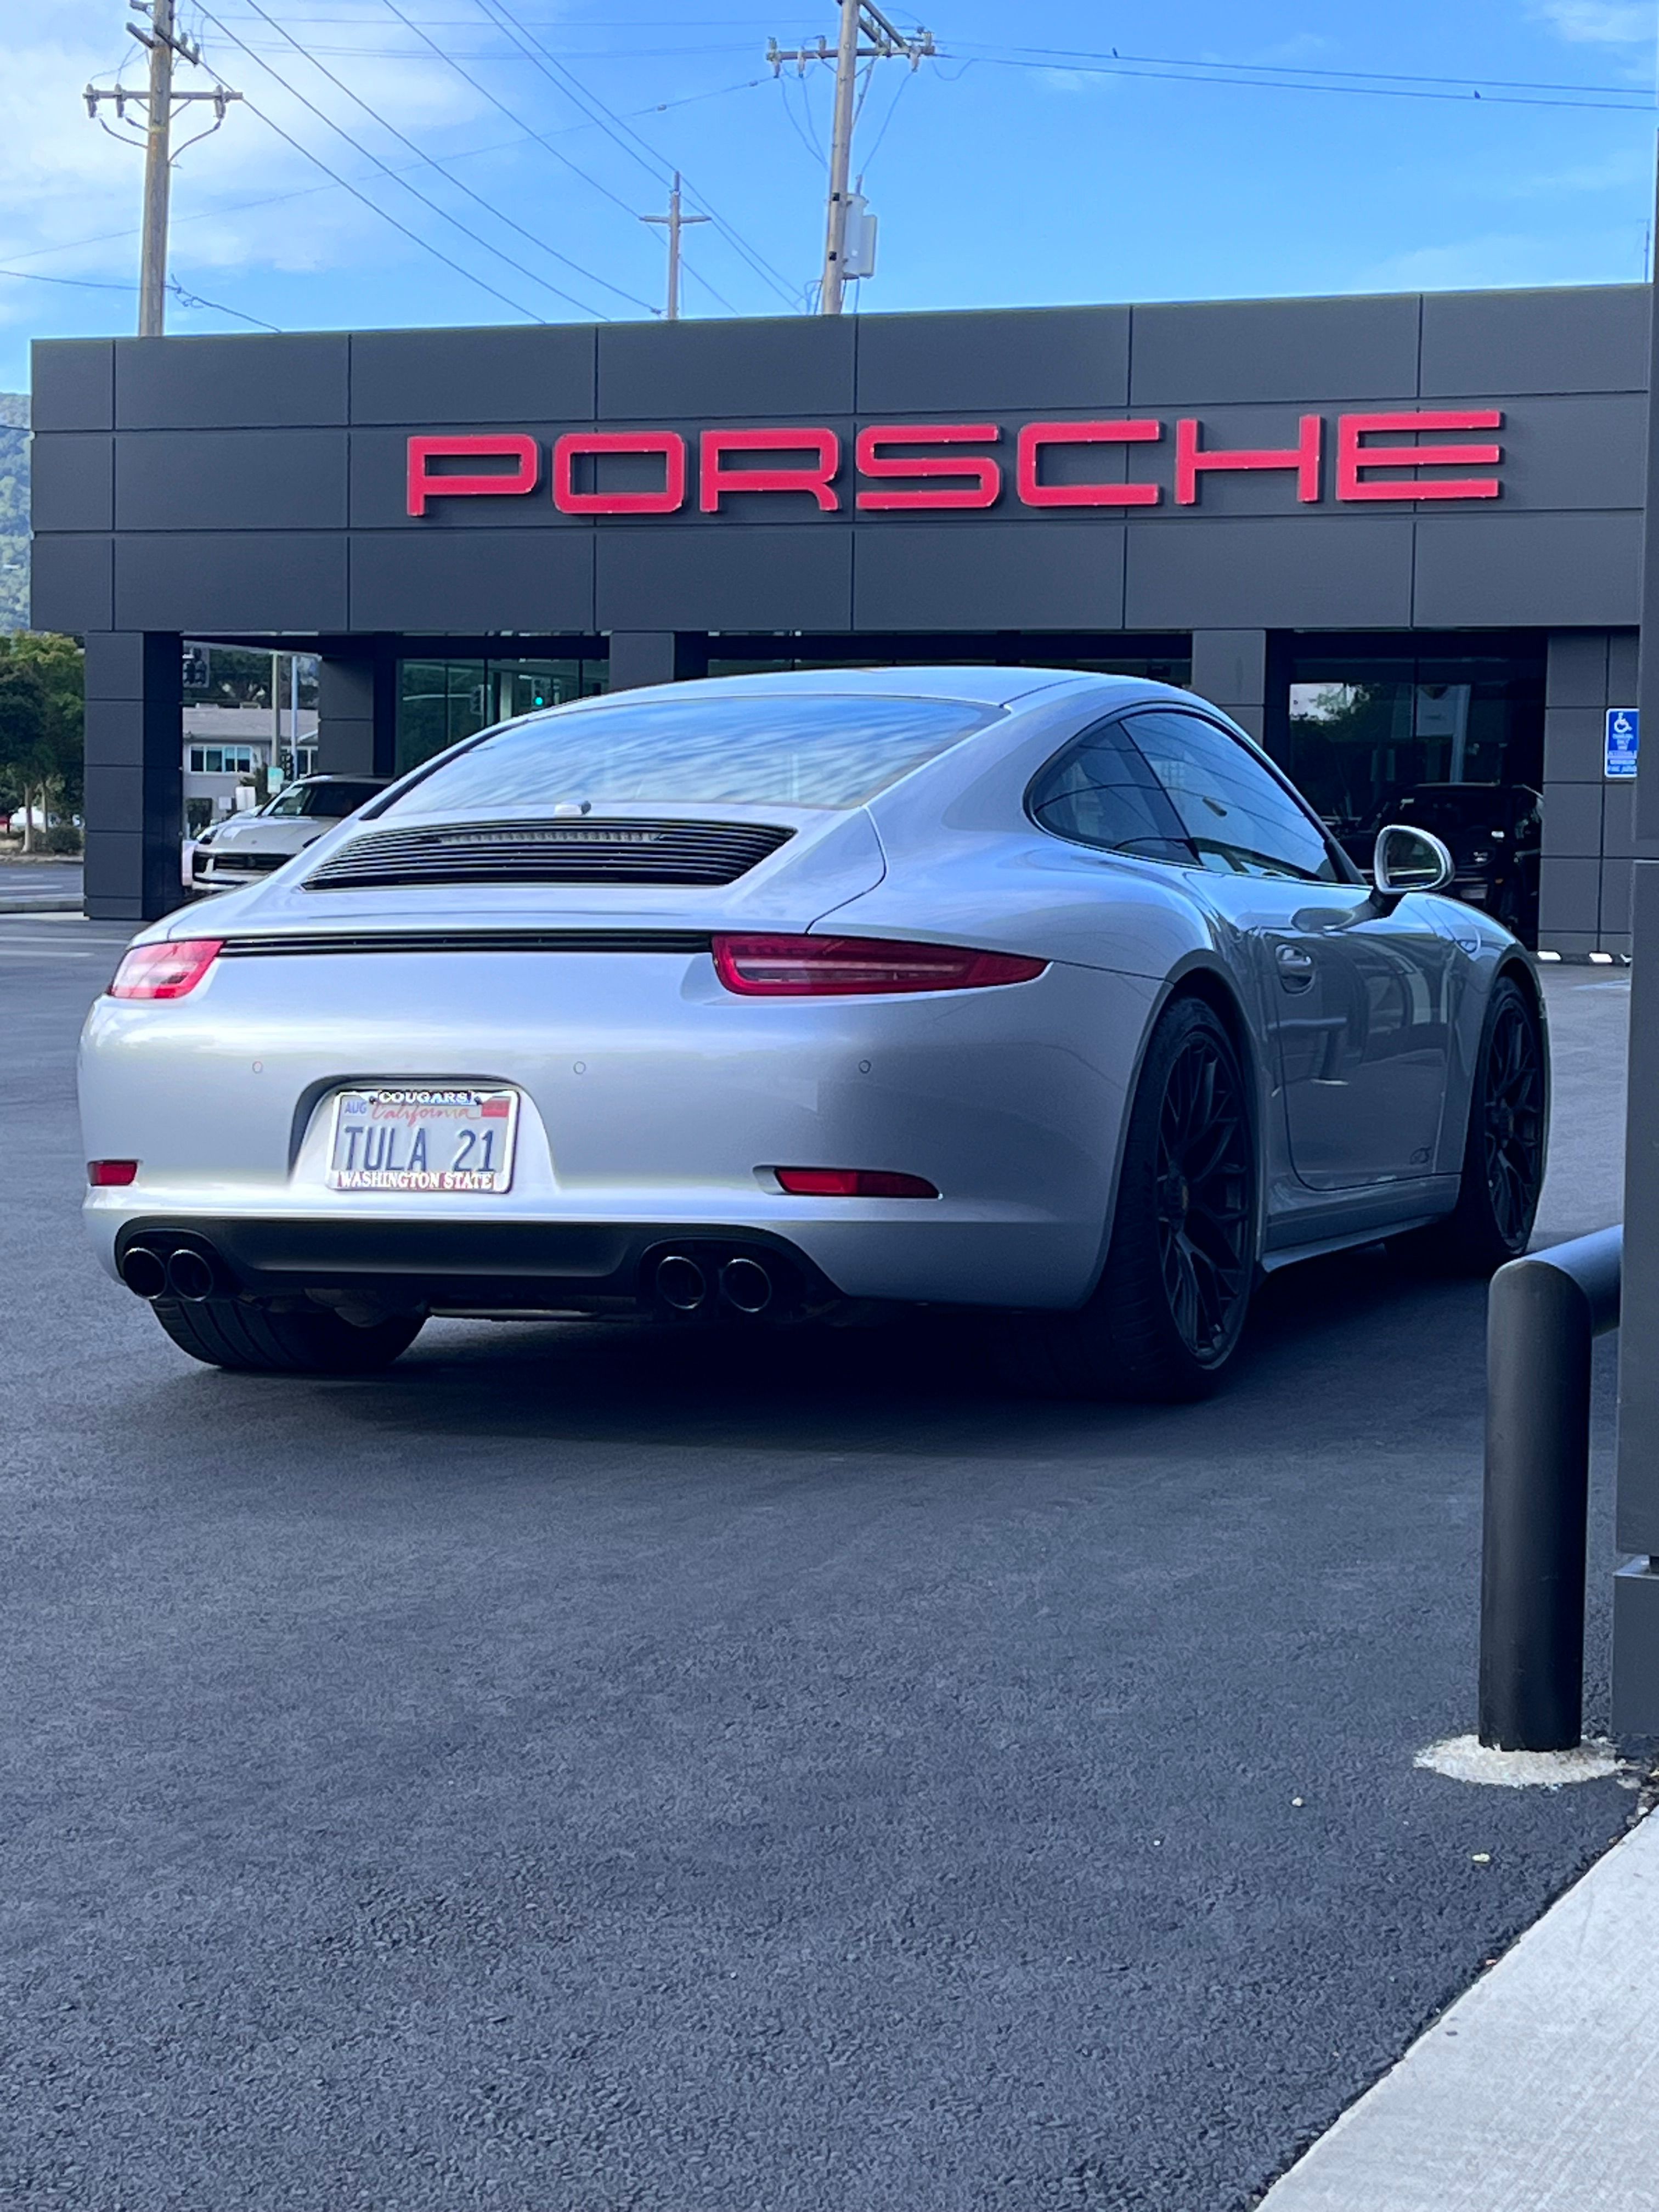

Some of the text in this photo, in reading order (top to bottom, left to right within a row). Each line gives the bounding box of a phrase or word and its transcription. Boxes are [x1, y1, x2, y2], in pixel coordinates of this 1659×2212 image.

[407, 409, 1502, 517] PORSCHE
[344, 1100, 367, 1114] AUG
[378, 1091, 468, 1104] COUGARS
[371, 1102, 482, 1125] California
[344, 1125, 495, 1172] TULA 21
[340, 1171, 492, 1189] WASHINGTON STATE
